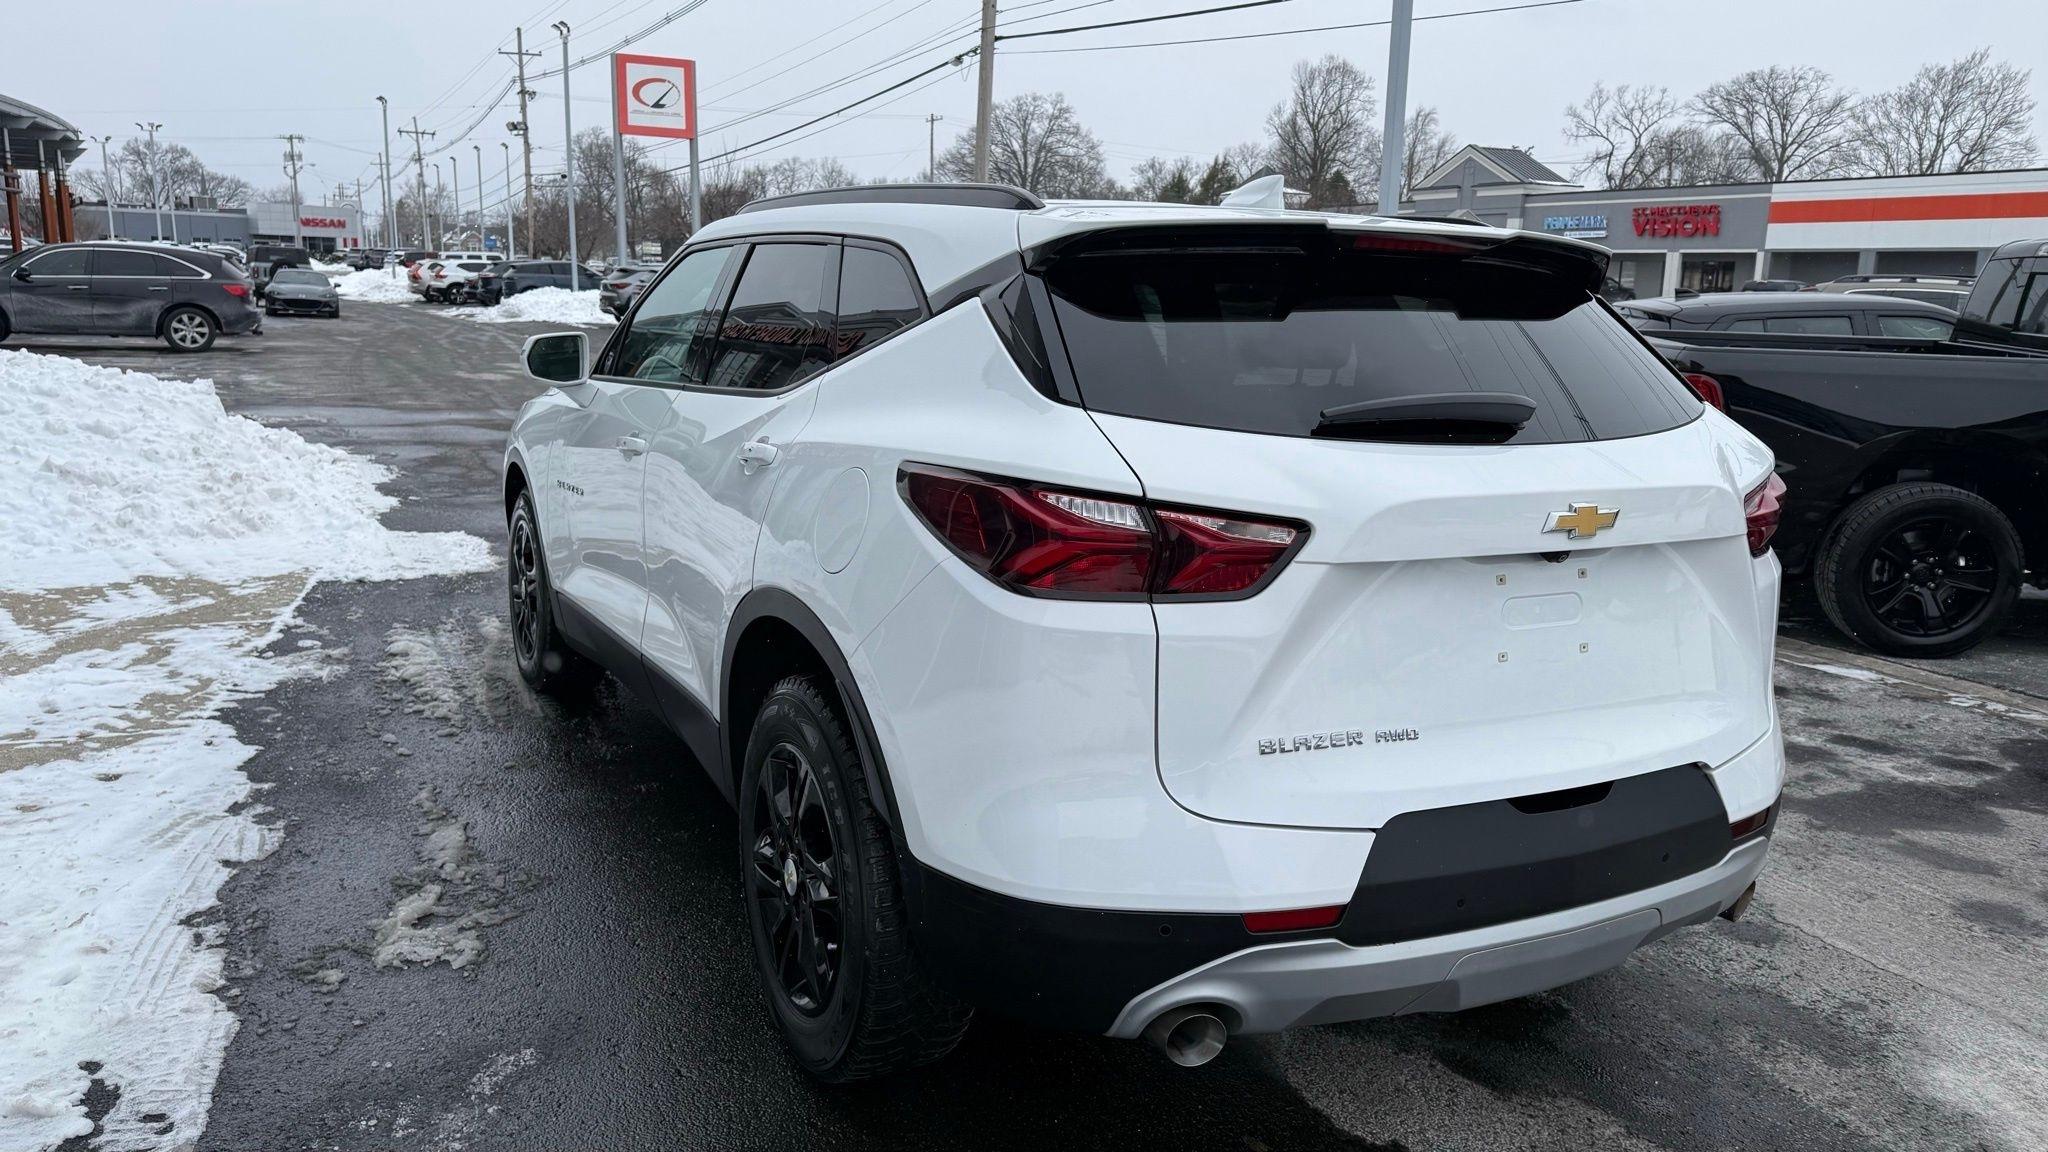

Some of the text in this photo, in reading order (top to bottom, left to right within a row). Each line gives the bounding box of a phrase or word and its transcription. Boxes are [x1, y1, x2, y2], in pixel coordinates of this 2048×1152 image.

[299, 216, 346, 229] NISSAN
[1632, 214, 1720, 237] VISION
[1258, 728, 1419, 755] BLAZER AWD
